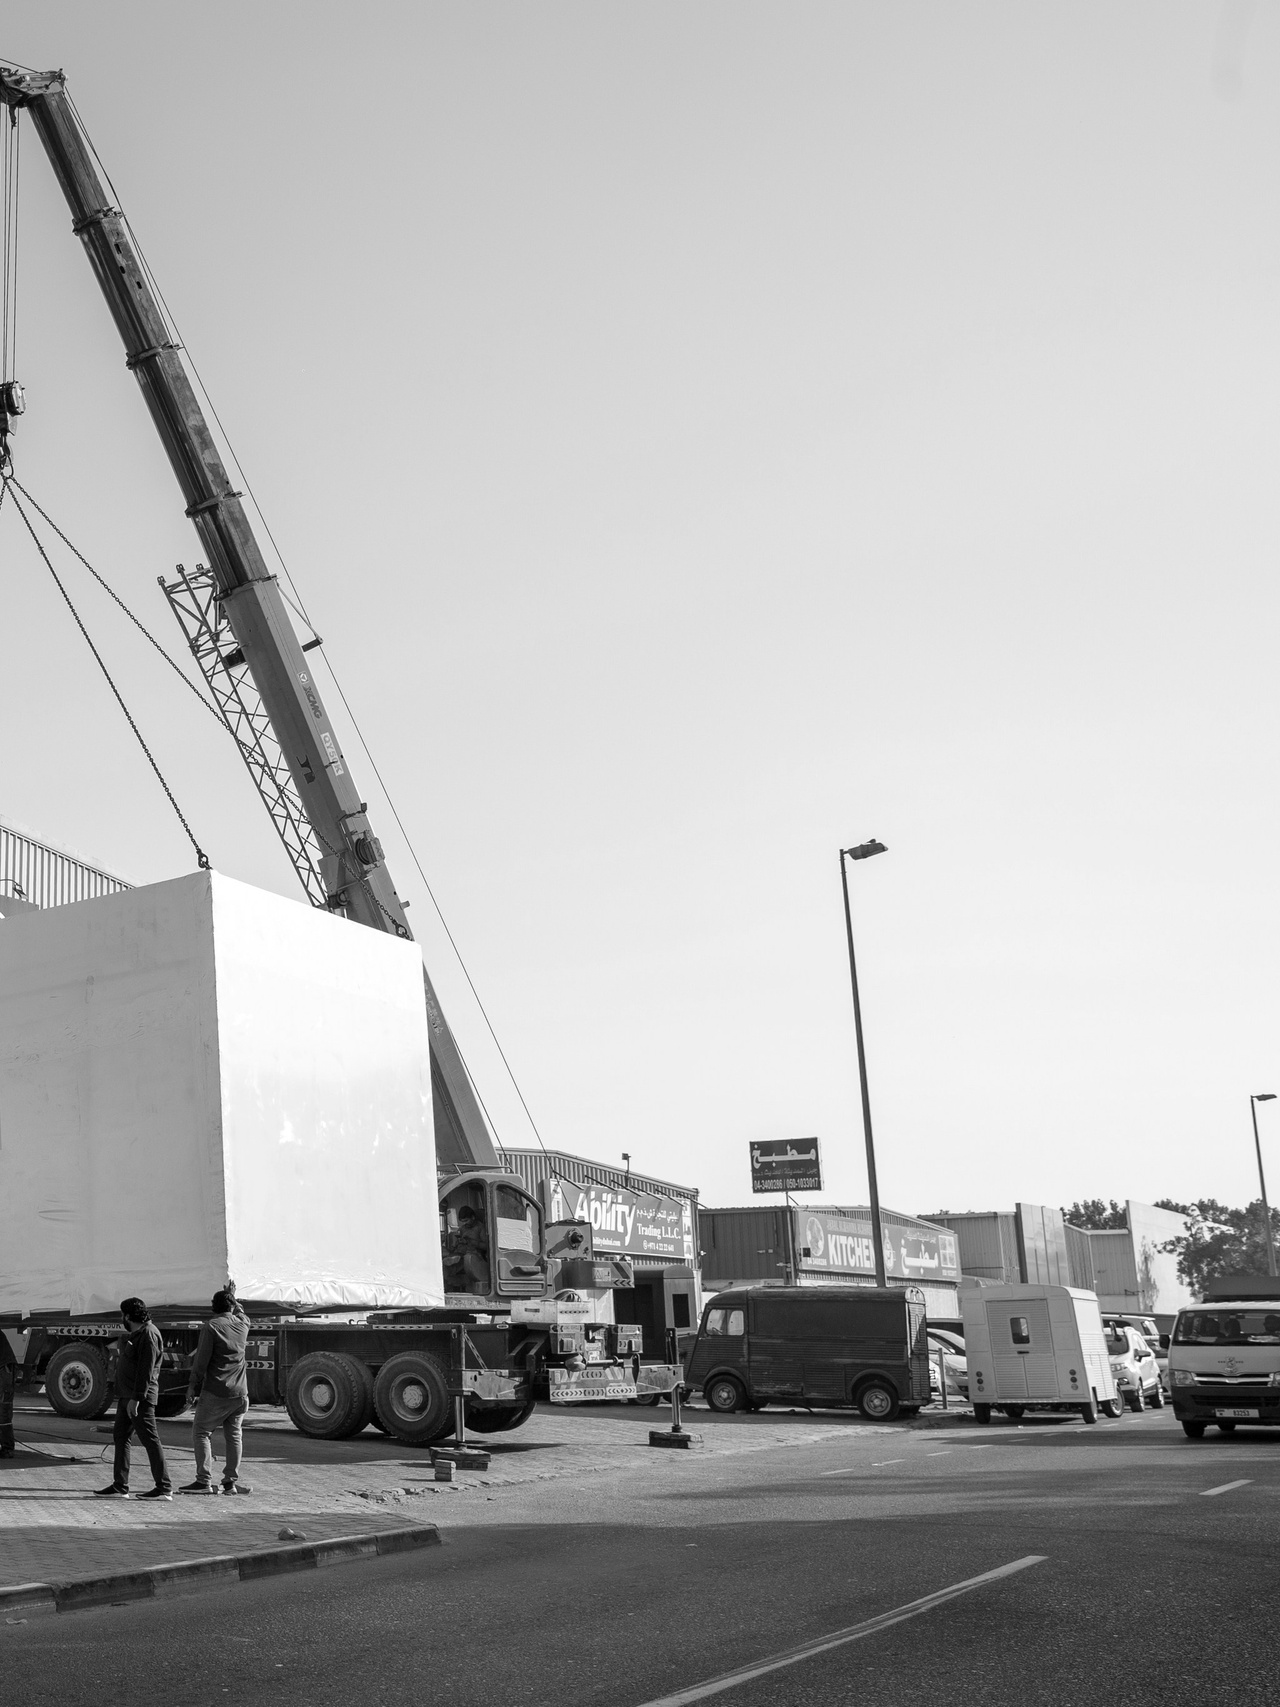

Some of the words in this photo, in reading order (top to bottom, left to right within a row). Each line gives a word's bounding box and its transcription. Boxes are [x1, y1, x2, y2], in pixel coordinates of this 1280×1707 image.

[302, 685, 323, 719] XCMG
[752, 1143, 816, 1169] مطبخ
[574, 1191, 636, 1247] Ability
[636, 1223, 661, 1240] Trading
[662, 1225, 681, 1240] L.L.C.
[827, 1233, 876, 1269] KITCHEN
[900, 1238, 939, 1275] مطبخ
